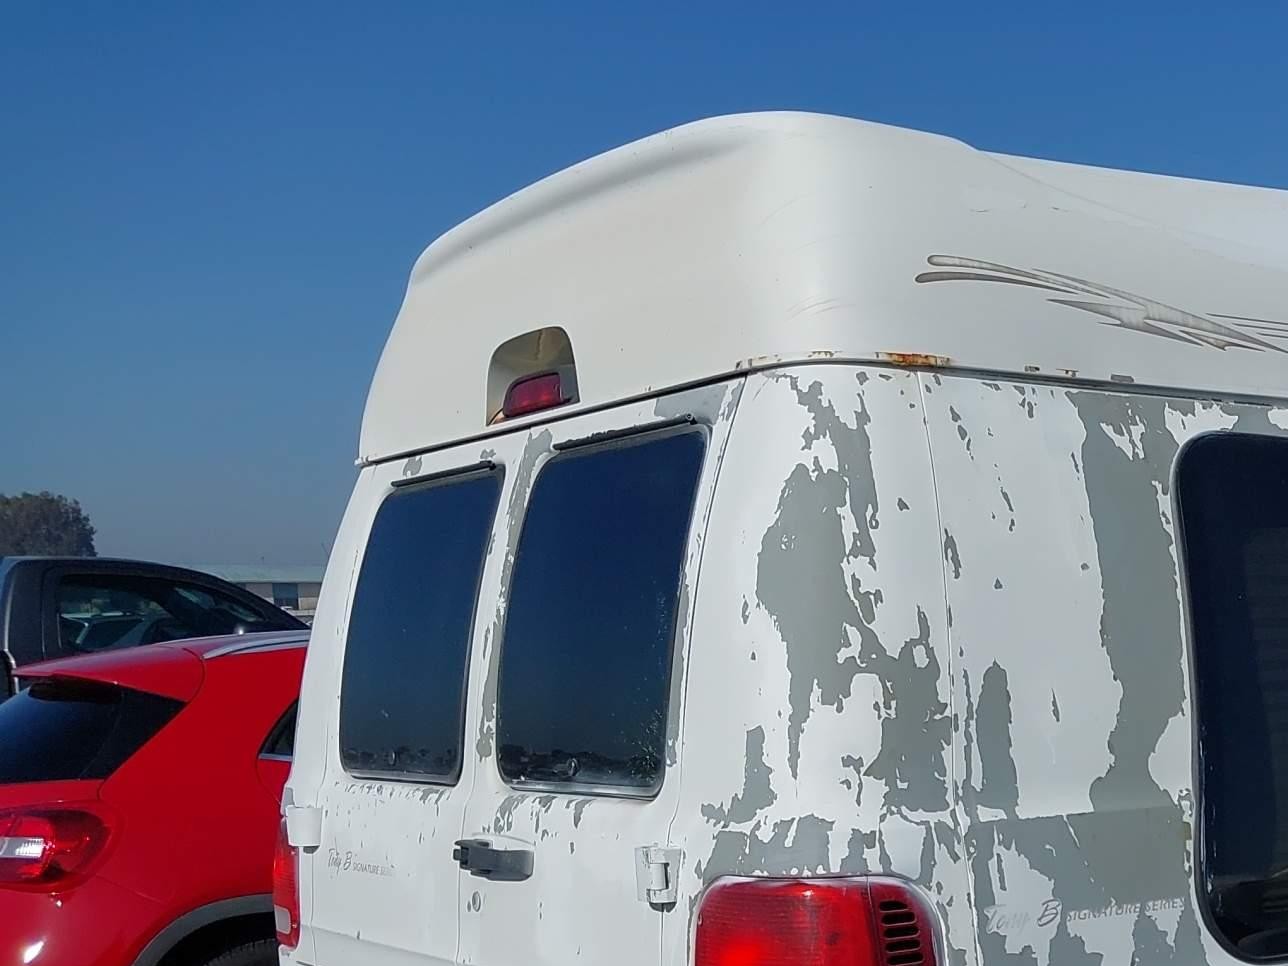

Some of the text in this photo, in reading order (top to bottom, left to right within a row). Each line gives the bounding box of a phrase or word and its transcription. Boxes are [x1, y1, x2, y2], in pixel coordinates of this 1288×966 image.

[1038, 898, 1061, 928] B
[1066, 903, 1142, 922] SIGNATURE
[1144, 896, 1185, 913] SERIES
